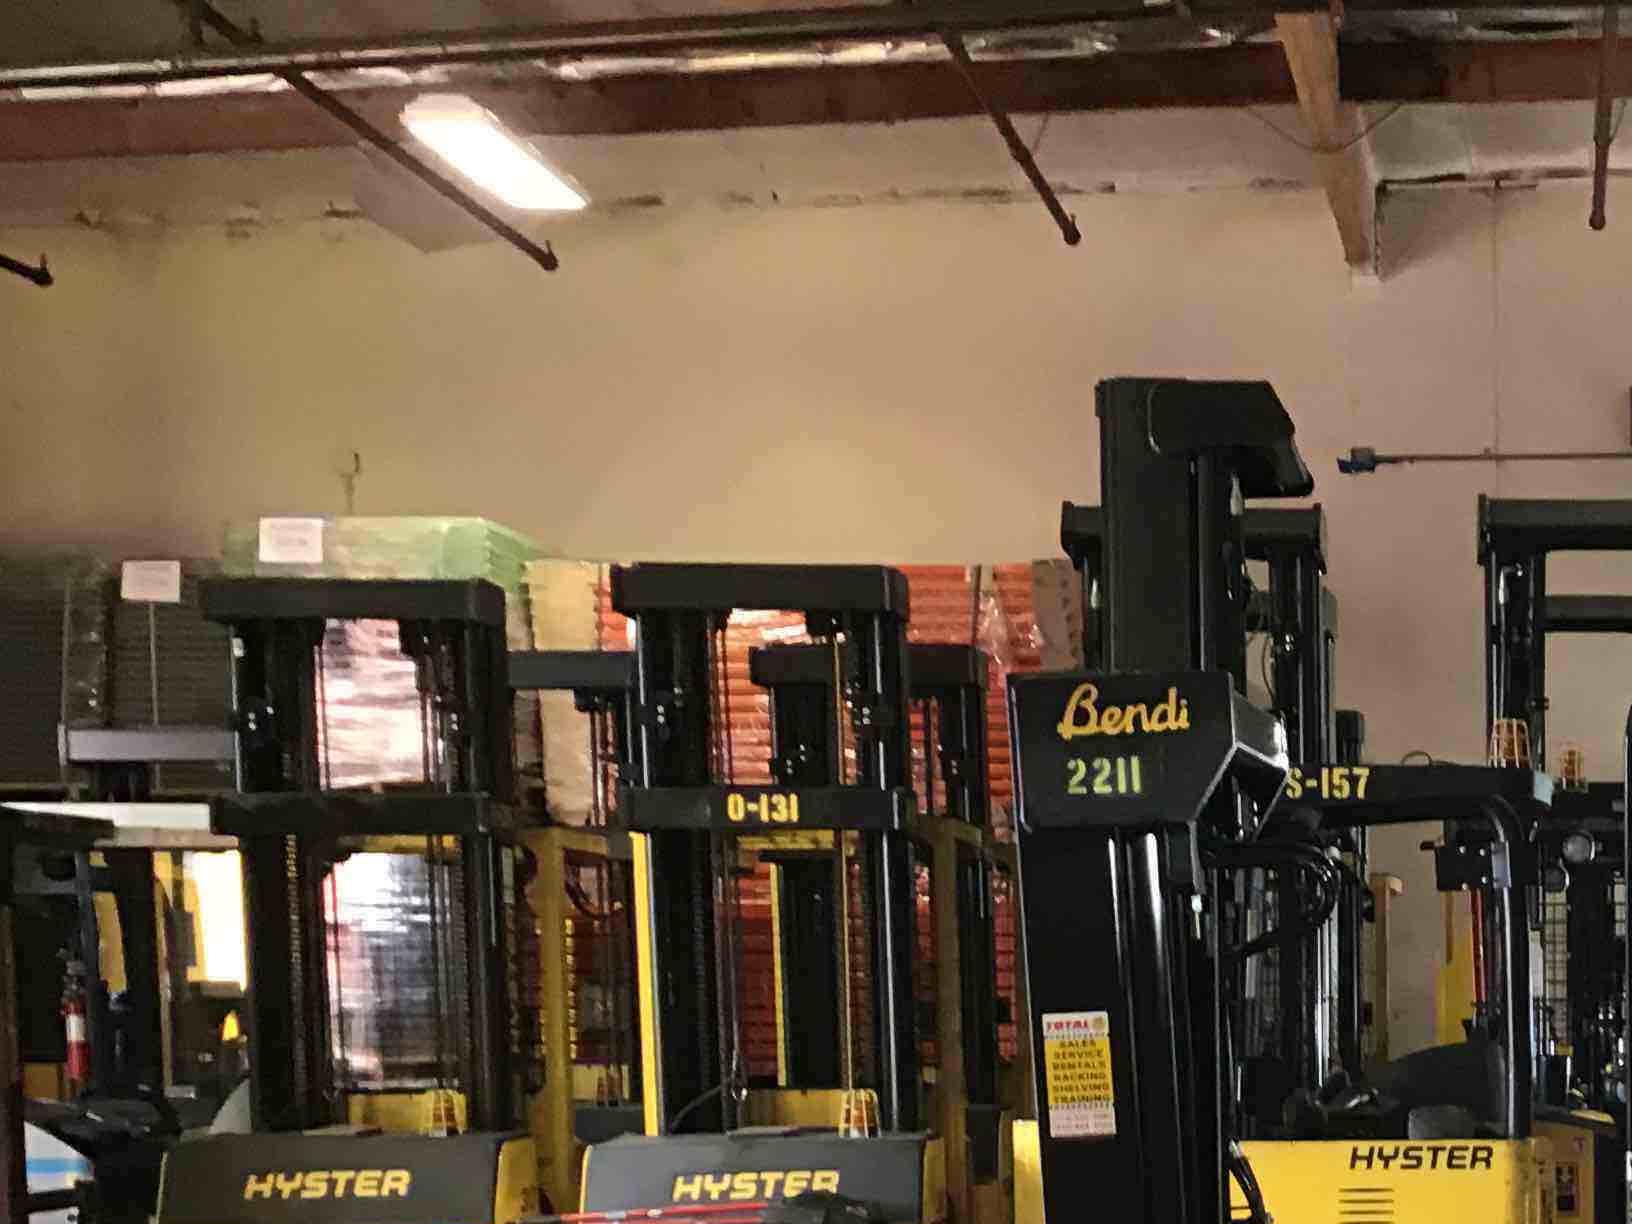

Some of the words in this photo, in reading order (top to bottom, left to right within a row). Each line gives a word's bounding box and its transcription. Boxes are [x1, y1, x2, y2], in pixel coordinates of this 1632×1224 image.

[1057, 683, 1190, 741] Bendi
[1067, 756, 1141, 794] 2211
[1286, 767, 1370, 799] S-157
[1059, 1039, 1096, 1048] SALES
[1054, 1049, 1104, 1059] SERVICE
[1052, 1060, 1106, 1070] RENTALS
[1053, 1071, 1106, 1082] RACKING
[1053, 1082, 1110, 1093] SHELVING
[1054, 1093, 1111, 1104] TRAINING
[1350, 1144, 1493, 1170] HYSTER
[244, 1169, 411, 1199] HYSTER
[672, 1170, 840, 1201] HYSTER
